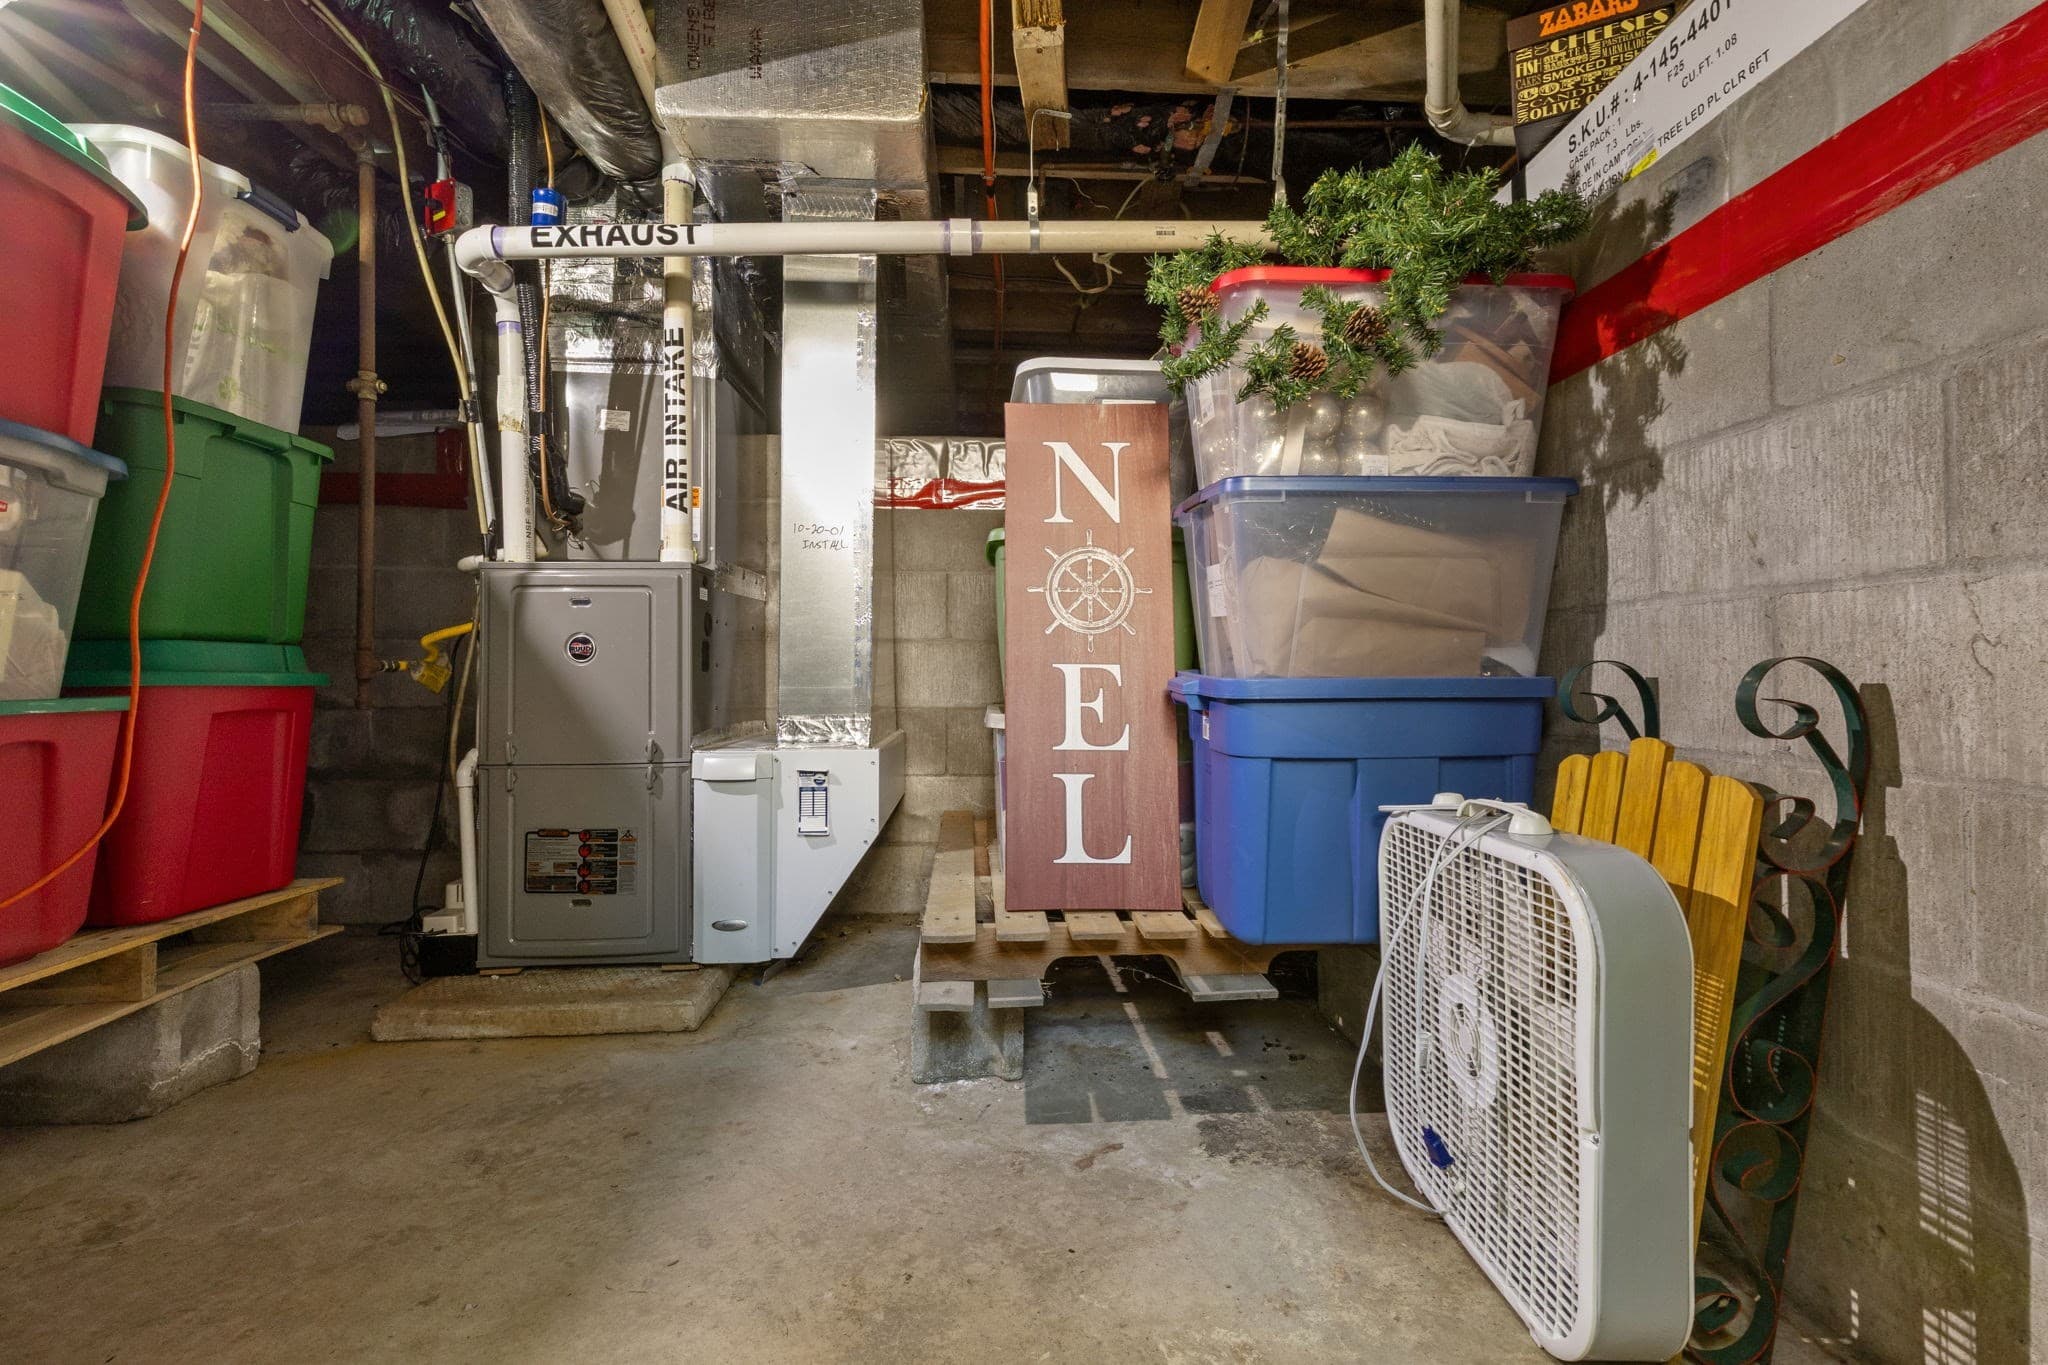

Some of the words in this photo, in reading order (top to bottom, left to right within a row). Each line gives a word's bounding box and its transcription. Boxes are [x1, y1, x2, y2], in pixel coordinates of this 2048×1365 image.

[1550, 8, 1669, 53] CHEESES
[1602, 29, 1646, 47] PASTRAMI
[1602, 38, 1646, 57] MARMALADE
[1716, 33, 1738, 58] 1.08
[1516, 57, 1542, 78] FISH
[1543, 54, 1588, 73] BASKETS
[1543, 59, 1606, 83] SMOKED
[1667, 59, 1685, 82] F25
[1516, 73, 1542, 90] CAKES
[1517, 63, 1626, 101] COFFE
[1530, 79, 1611, 108] CANDIE
[1529, 98, 1581, 120] OLIVE
[1657, 120, 1683, 147] TREE
[1685, 103, 1706, 127] LED
[1707, 91, 1721, 110] PL
[1722, 69, 1747, 96] CLR
[1748, 48, 1771, 74] 6FT
[1516, 102, 1529, 124] SOUP
[1569, 146, 1589, 169] CASE
[1576, 177, 1593, 194] ADE
[1594, 169, 1602, 181] IN
[530, 223, 702, 249] EXHAUST
[664, 327, 687, 446] INTAKE
[665, 458, 688, 515] AIR
